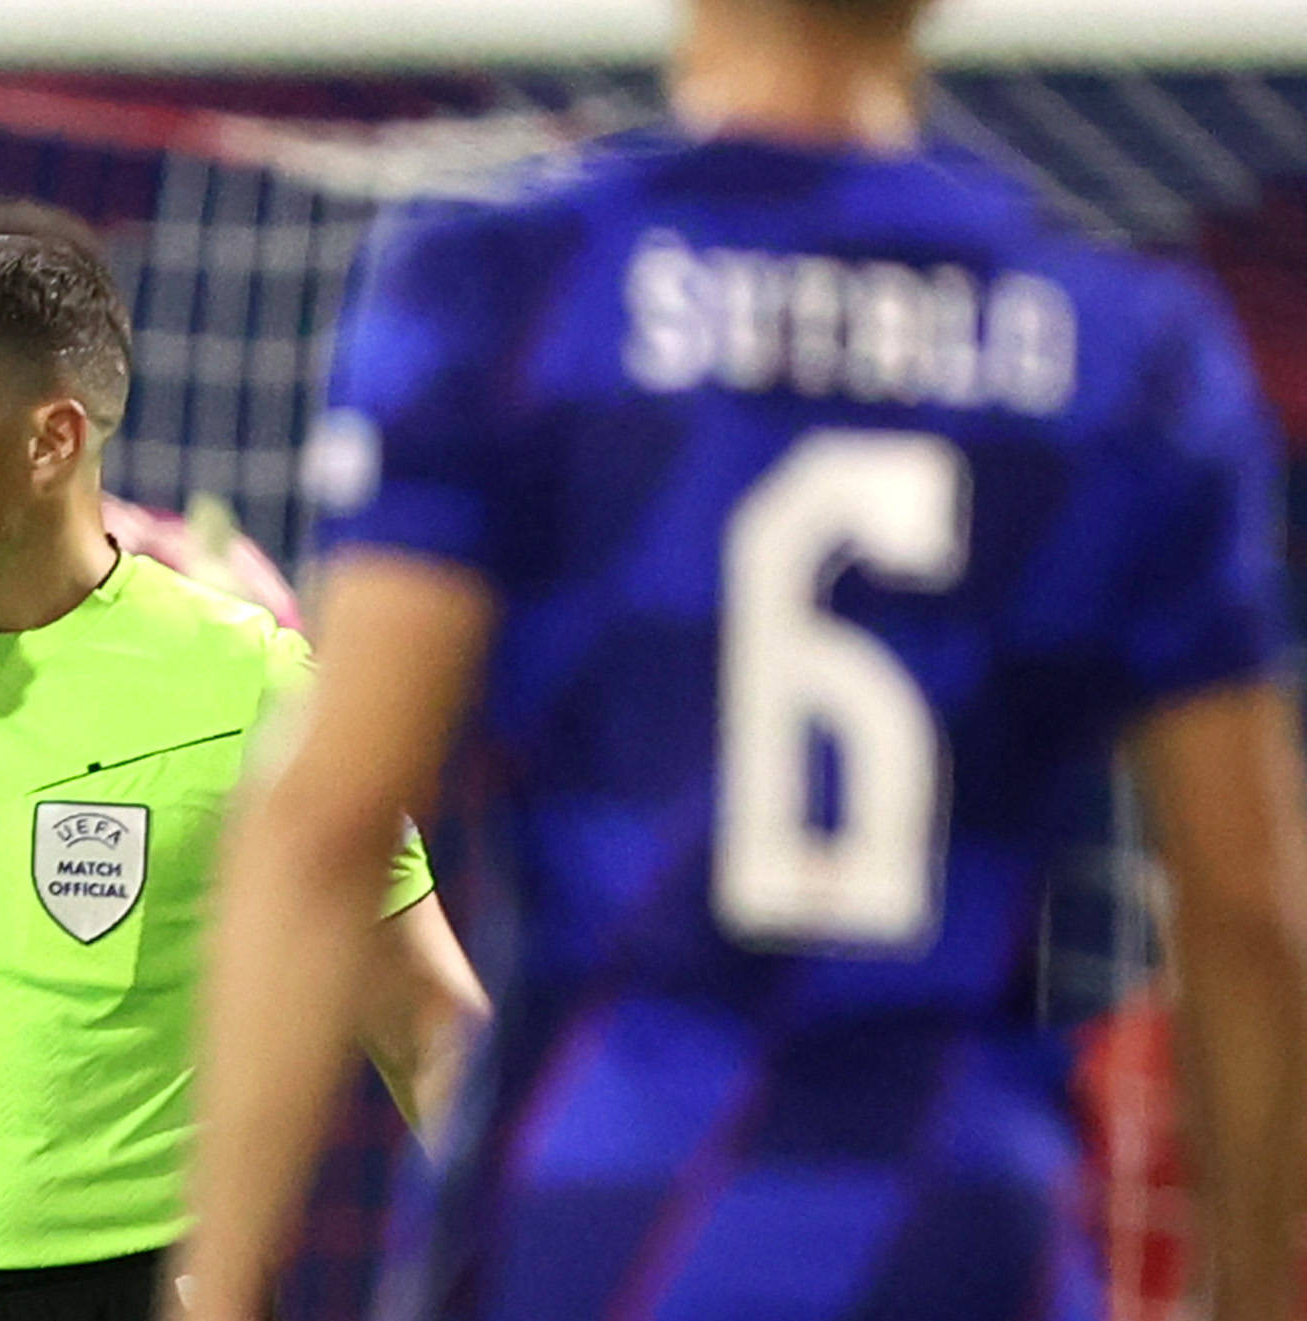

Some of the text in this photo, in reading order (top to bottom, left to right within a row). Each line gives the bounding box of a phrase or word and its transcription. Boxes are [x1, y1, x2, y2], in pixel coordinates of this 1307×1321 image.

[715, 428, 971, 956] 6
[57, 818, 121, 845] UEFA
[58, 861, 121, 876] MATCH
[49, 882, 127, 898] OFFICIAL
